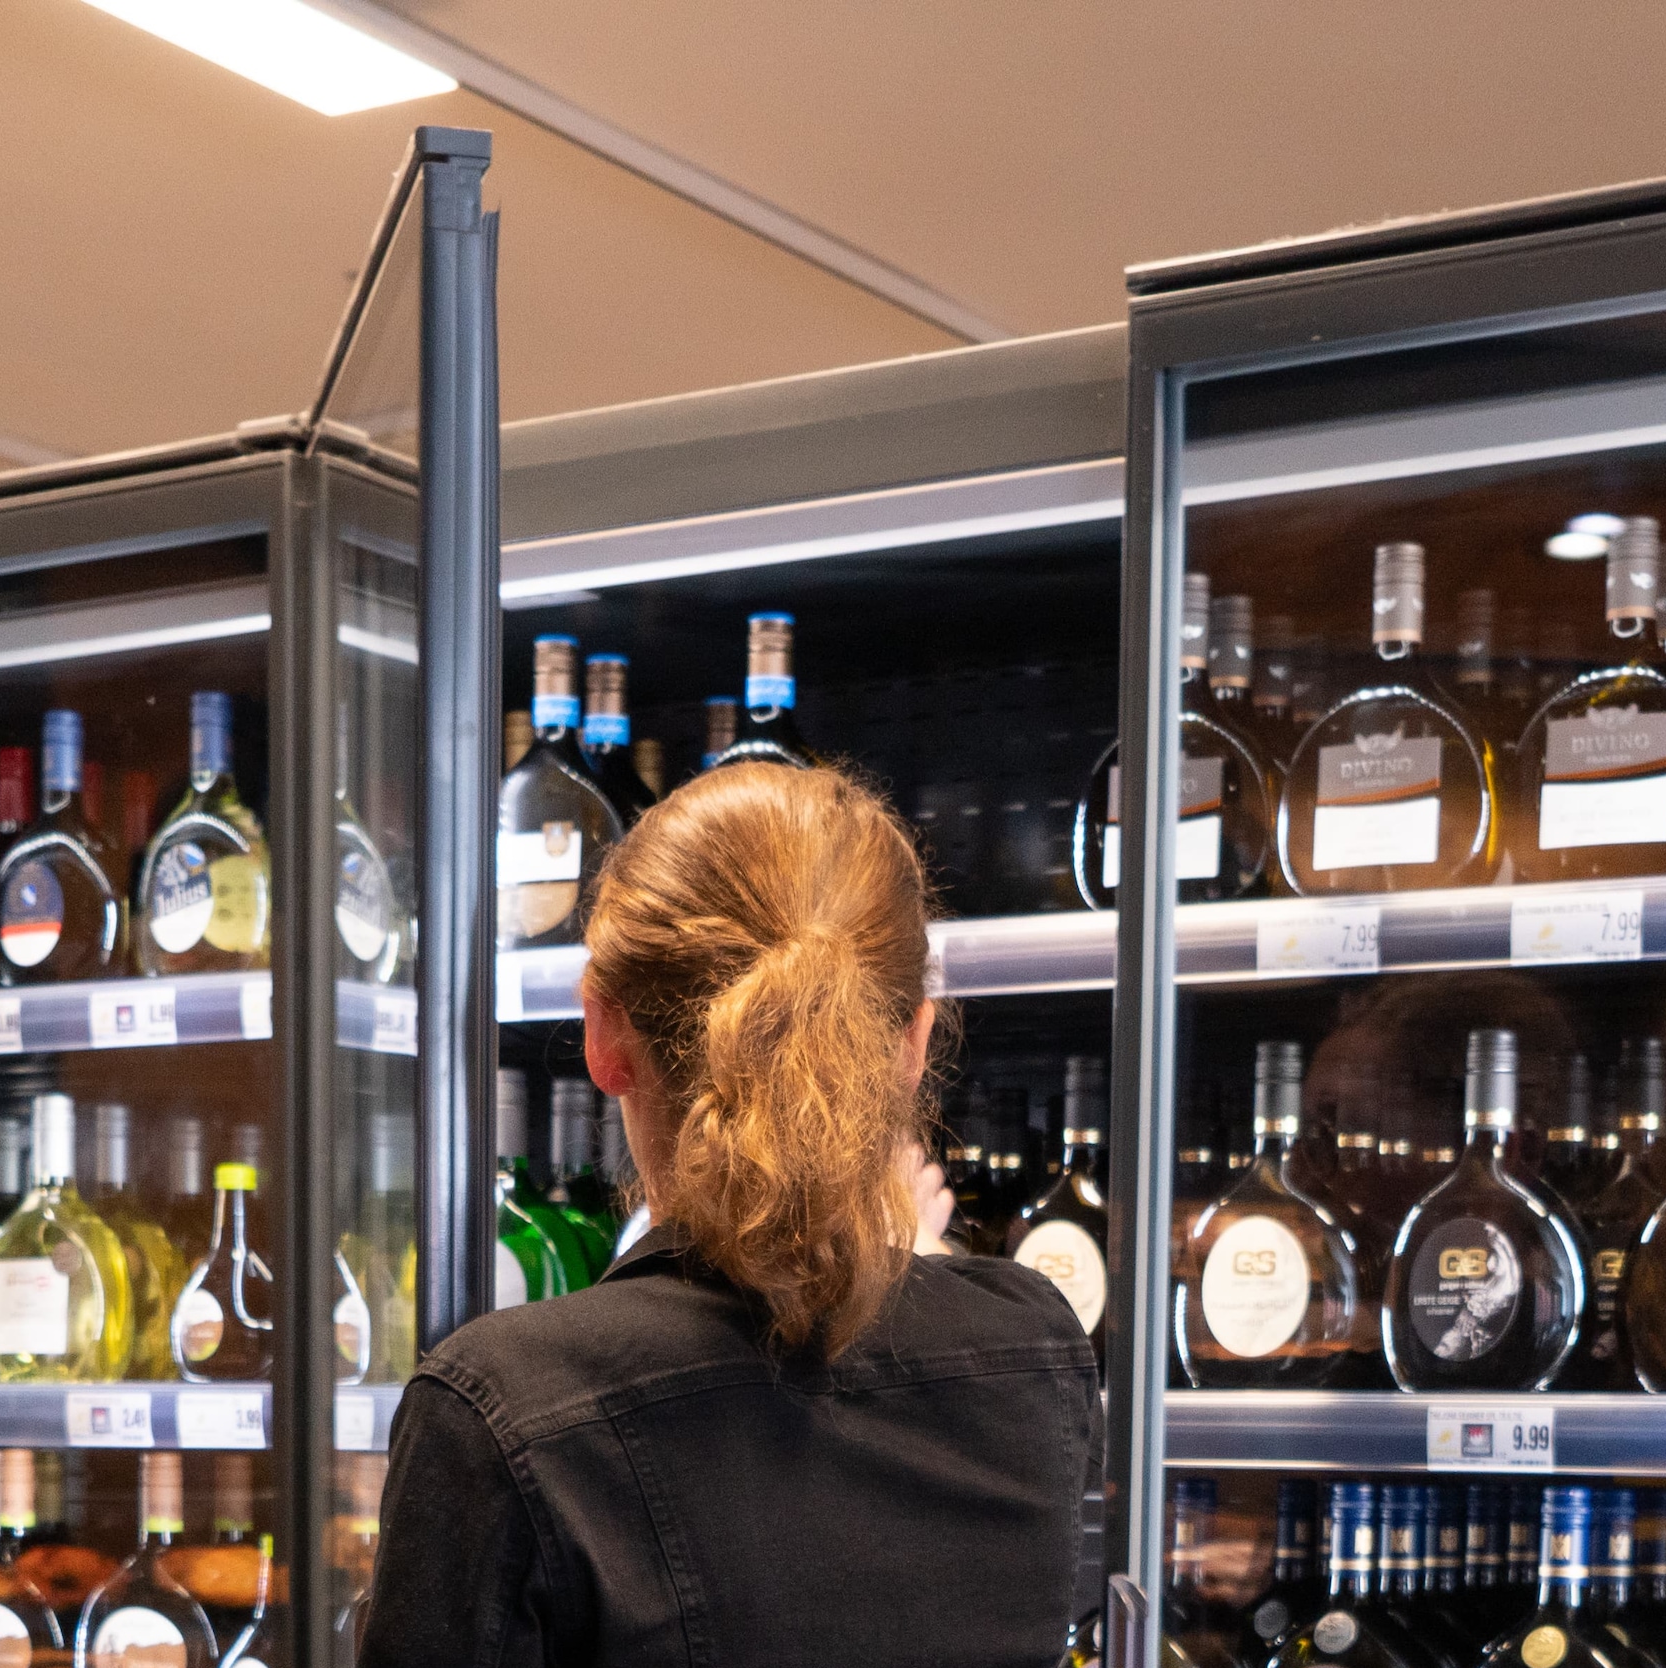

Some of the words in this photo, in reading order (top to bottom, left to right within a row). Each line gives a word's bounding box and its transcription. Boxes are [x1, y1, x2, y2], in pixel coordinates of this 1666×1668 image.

[1571, 732, 1649, 754] DIVINO
[1340, 758, 1410, 779] DIVINO
[1341, 923, 1378, 953] 7.99
[1601, 911, 1640, 942] 7.99
[1513, 1425, 1549, 1451] 9.99
